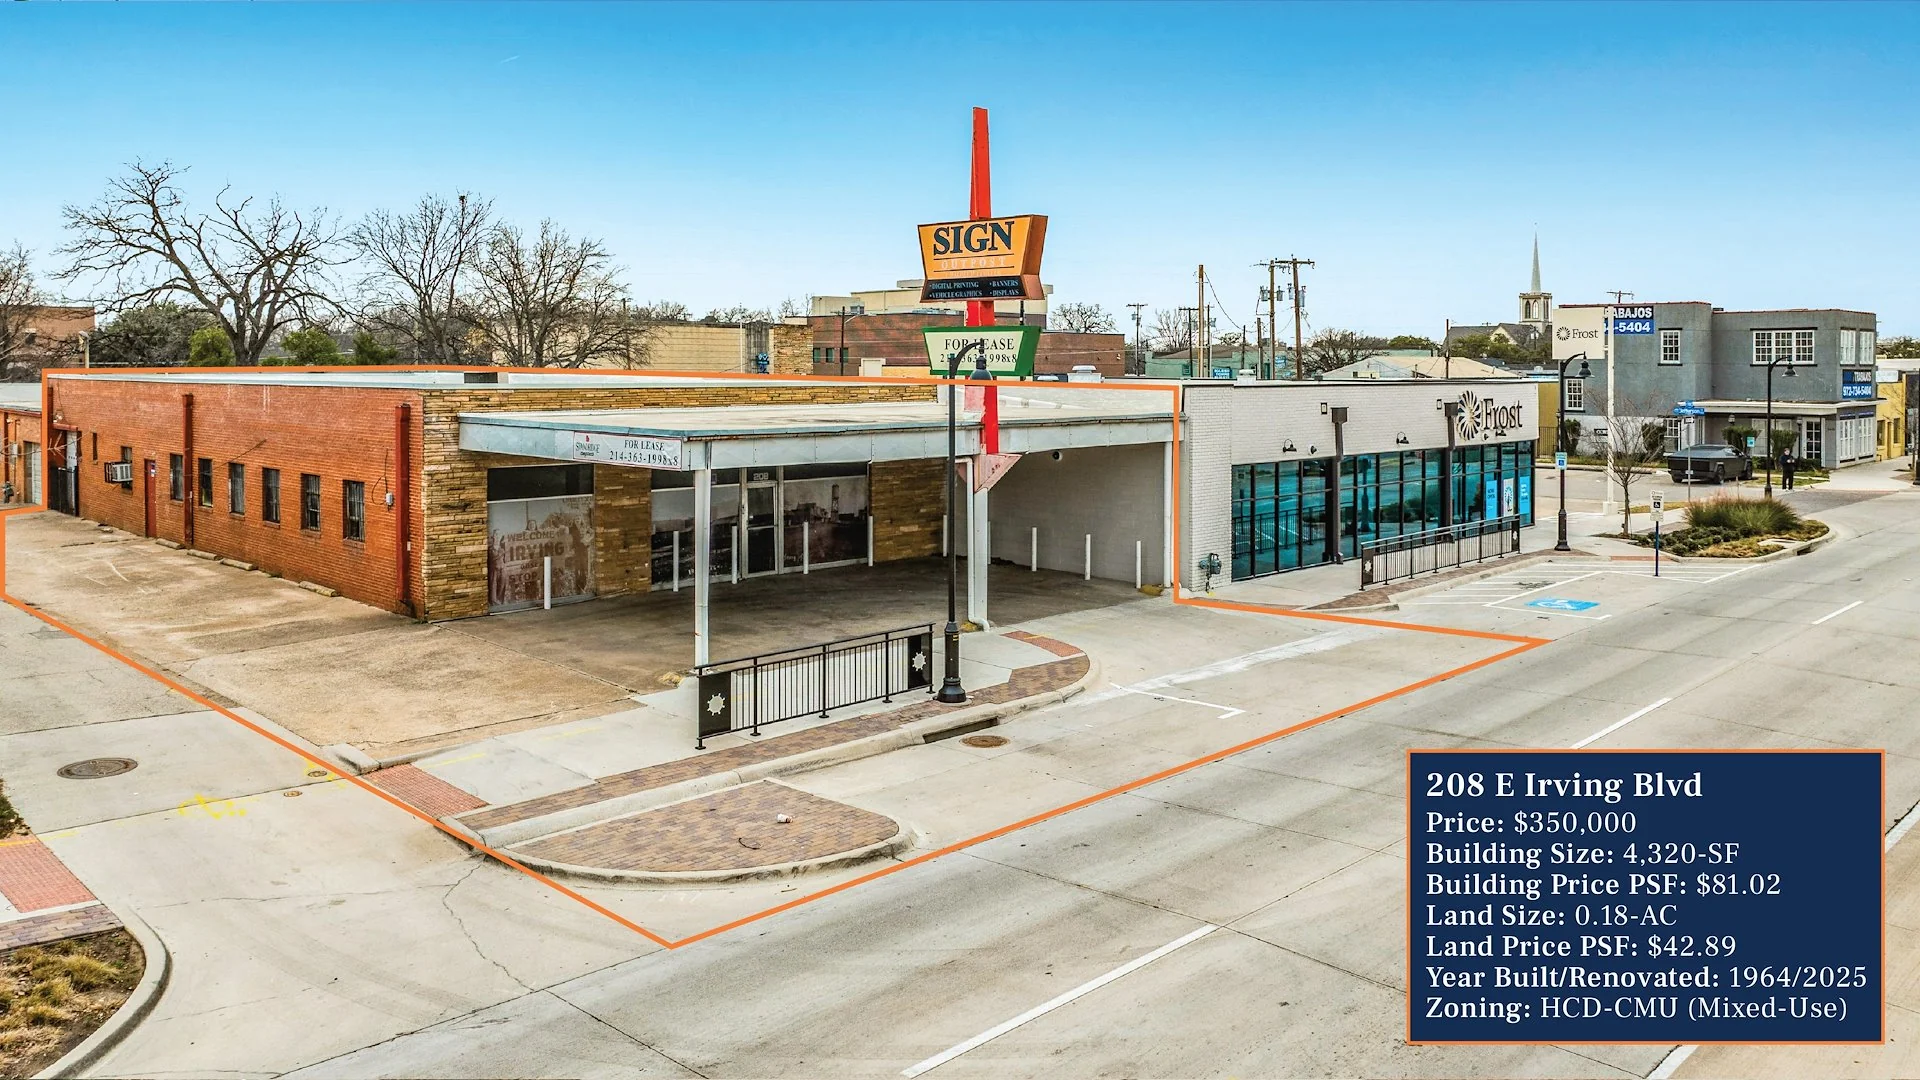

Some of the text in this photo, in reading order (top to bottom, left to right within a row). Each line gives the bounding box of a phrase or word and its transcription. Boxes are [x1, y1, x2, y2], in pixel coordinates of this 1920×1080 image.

[933, 220, 1015, 256] SIGN
[941, 256, 1007, 270] OUTPOST
[932, 281, 979, 290] DIGITAL PRINTING
[992, 279, 1019, 287] BANNERS
[932, 290, 983, 299] VEHICLE GRAPHICS
[992, 289, 1020, 297] DISPLAYS
[1571, 328, 1599, 339] Frost
[945, 337, 1015, 351] FOR LEASE
[1483, 398, 1523, 430] Frost
[624, 439, 665, 452] FOR LEASE
[753, 472, 769, 481] 208
[508, 530, 555, 542] WELCOME
[510, 540, 565, 562] IRVING
